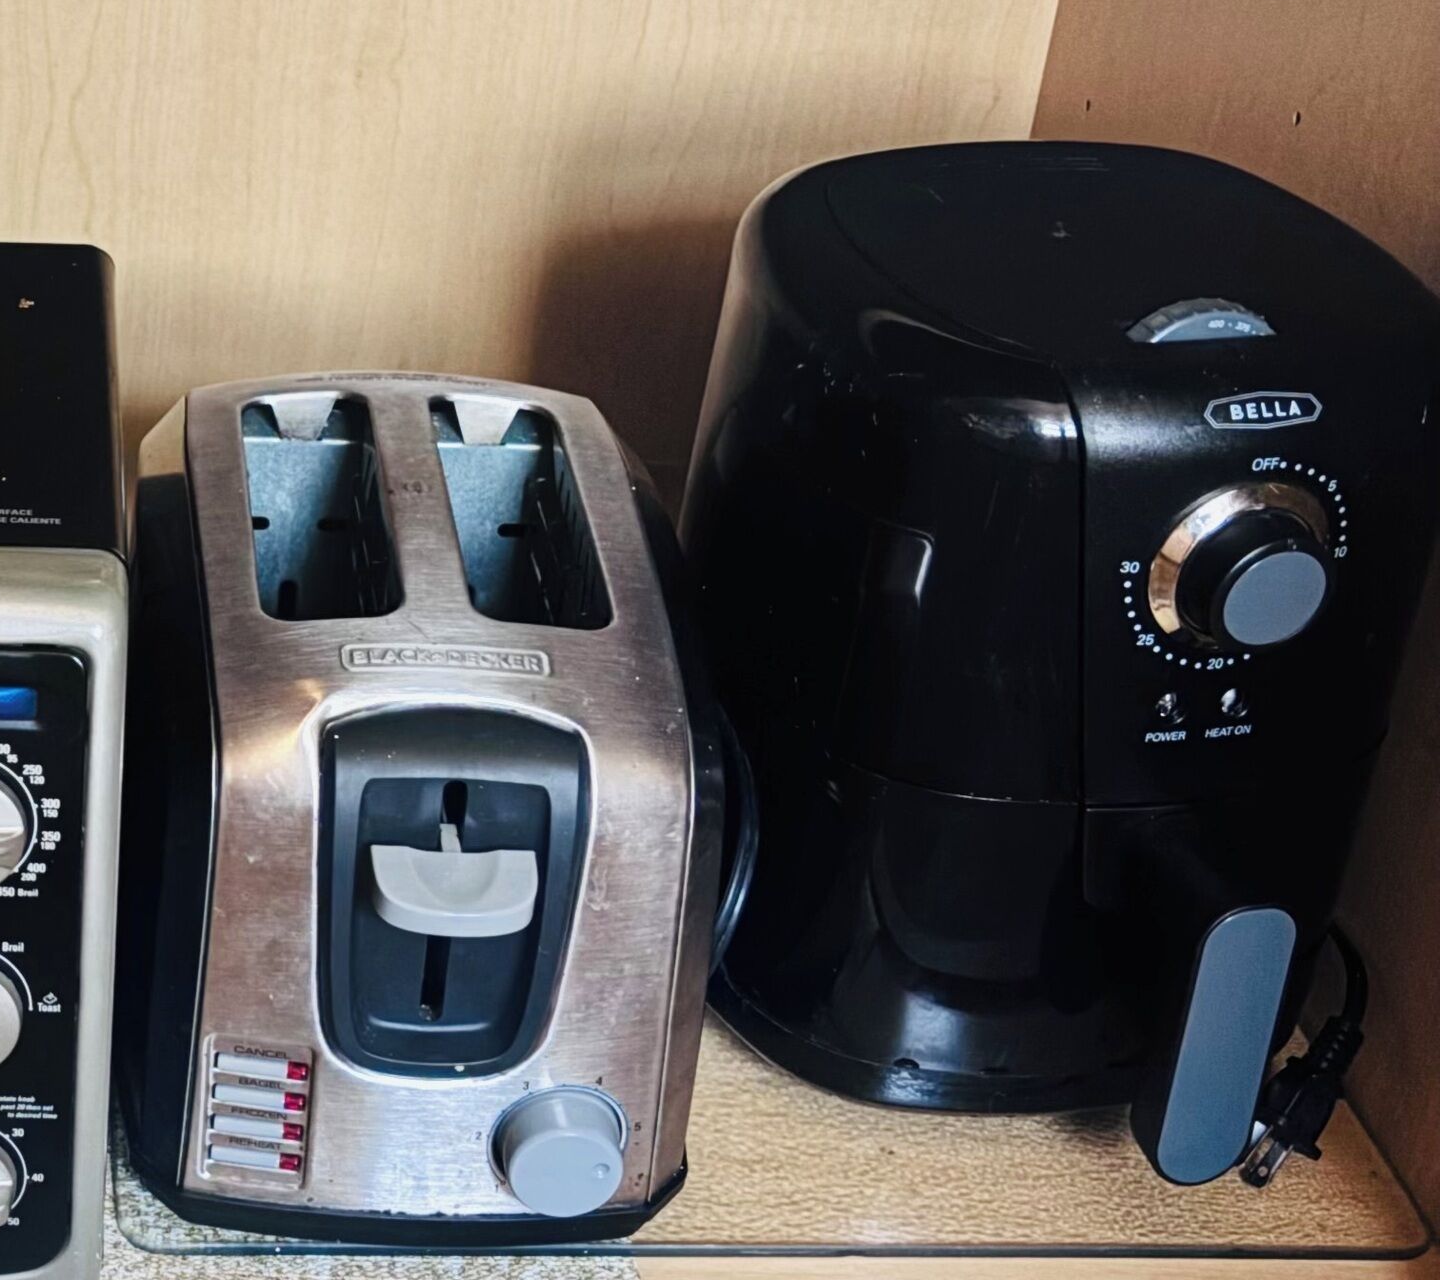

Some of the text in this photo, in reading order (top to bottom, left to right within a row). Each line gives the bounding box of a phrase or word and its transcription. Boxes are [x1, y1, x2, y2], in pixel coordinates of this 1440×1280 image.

[1230, 400, 1302, 420] BELLA
[1252, 457, 1280, 471] OFF
[1327, 480, 1337, 492] 5
[9, 517, 62, 525] CALIENTE
[1334, 546, 1347, 558] 10
[1120, 561, 1140, 573] 30
[1136, 634, 1155, 646] 25
[1206, 658, 1224, 670] 20
[1145, 731, 1186, 742] POWER
[1205, 724, 1252, 738] HEAT ON
[22, 764, 42, 775] 250
[29, 776, 45, 785] 120
[40, 798, 60, 809] 300
[43, 809, 58, 818] 150
[41, 831, 61, 842] 350
[40, 841, 56, 850] 180
[27, 862, 46, 873] 400
[21, 873, 37, 881] 200
[17, 888, 39, 897] Broil
[2, 941, 25, 952] Broil
[37, 1002, 62, 1013] Toast
[234, 1045, 289, 1059] CANCEL
[238, 1077, 285, 1090] BAGEL
[522, 1081, 530, 1090] 3
[595, 1076, 603, 1086] 4
[231, 1106, 287, 1120] FROZEN
[11, 1127, 25, 1137] 30
[634, 1122, 642, 1131] 5
[476, 1131, 482, 1140] 2
[229, 1136, 281, 1150] REHEAT
[31, 1173, 44, 1182] 40
[7, 1217, 20, 1226] 50
